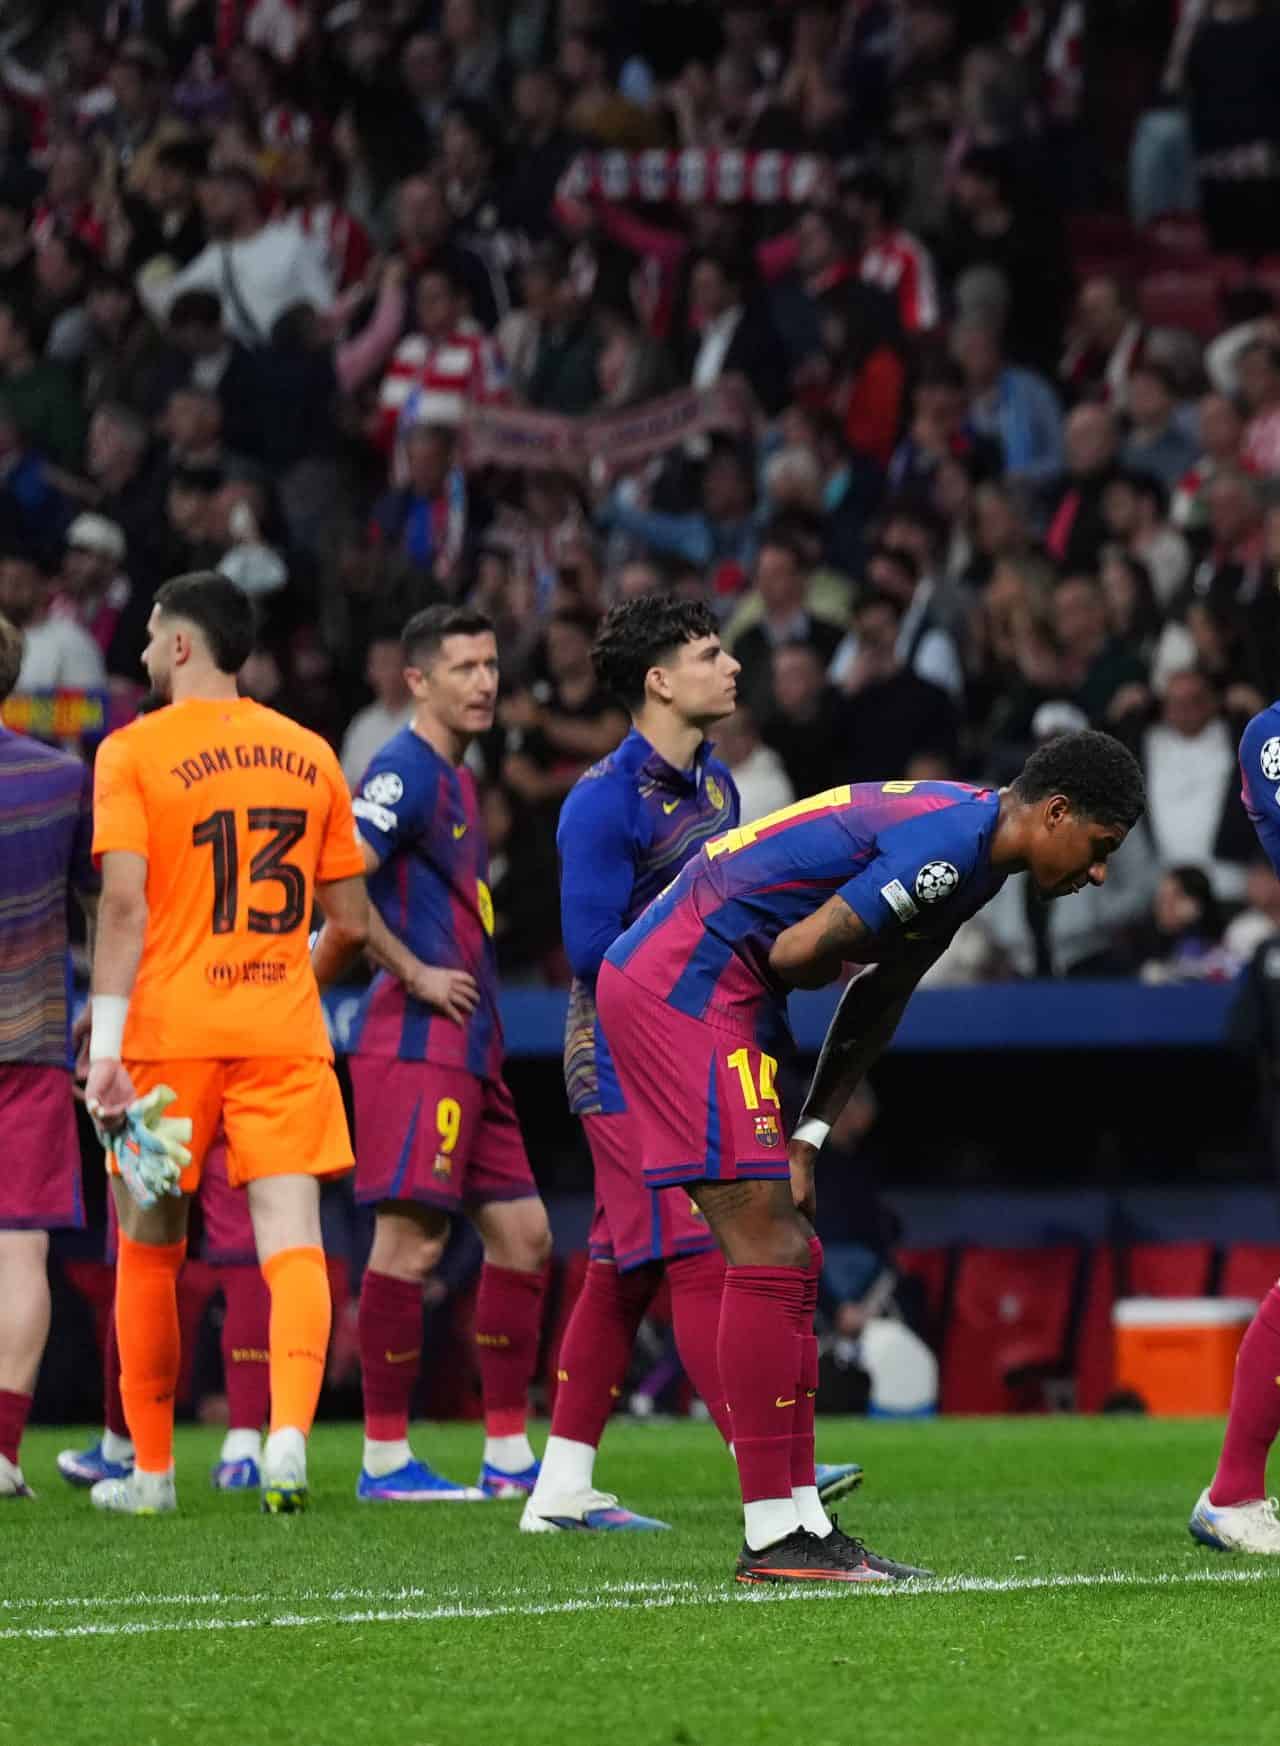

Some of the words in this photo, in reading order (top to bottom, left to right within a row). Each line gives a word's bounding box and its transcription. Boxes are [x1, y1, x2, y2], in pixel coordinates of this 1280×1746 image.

[170, 746, 233, 790] JOAN
[234, 744, 318, 787] GARCIA
[192, 807, 308, 936] 13
[726, 1047, 781, 1110] 14
[436, 1097, 462, 1154] 9
